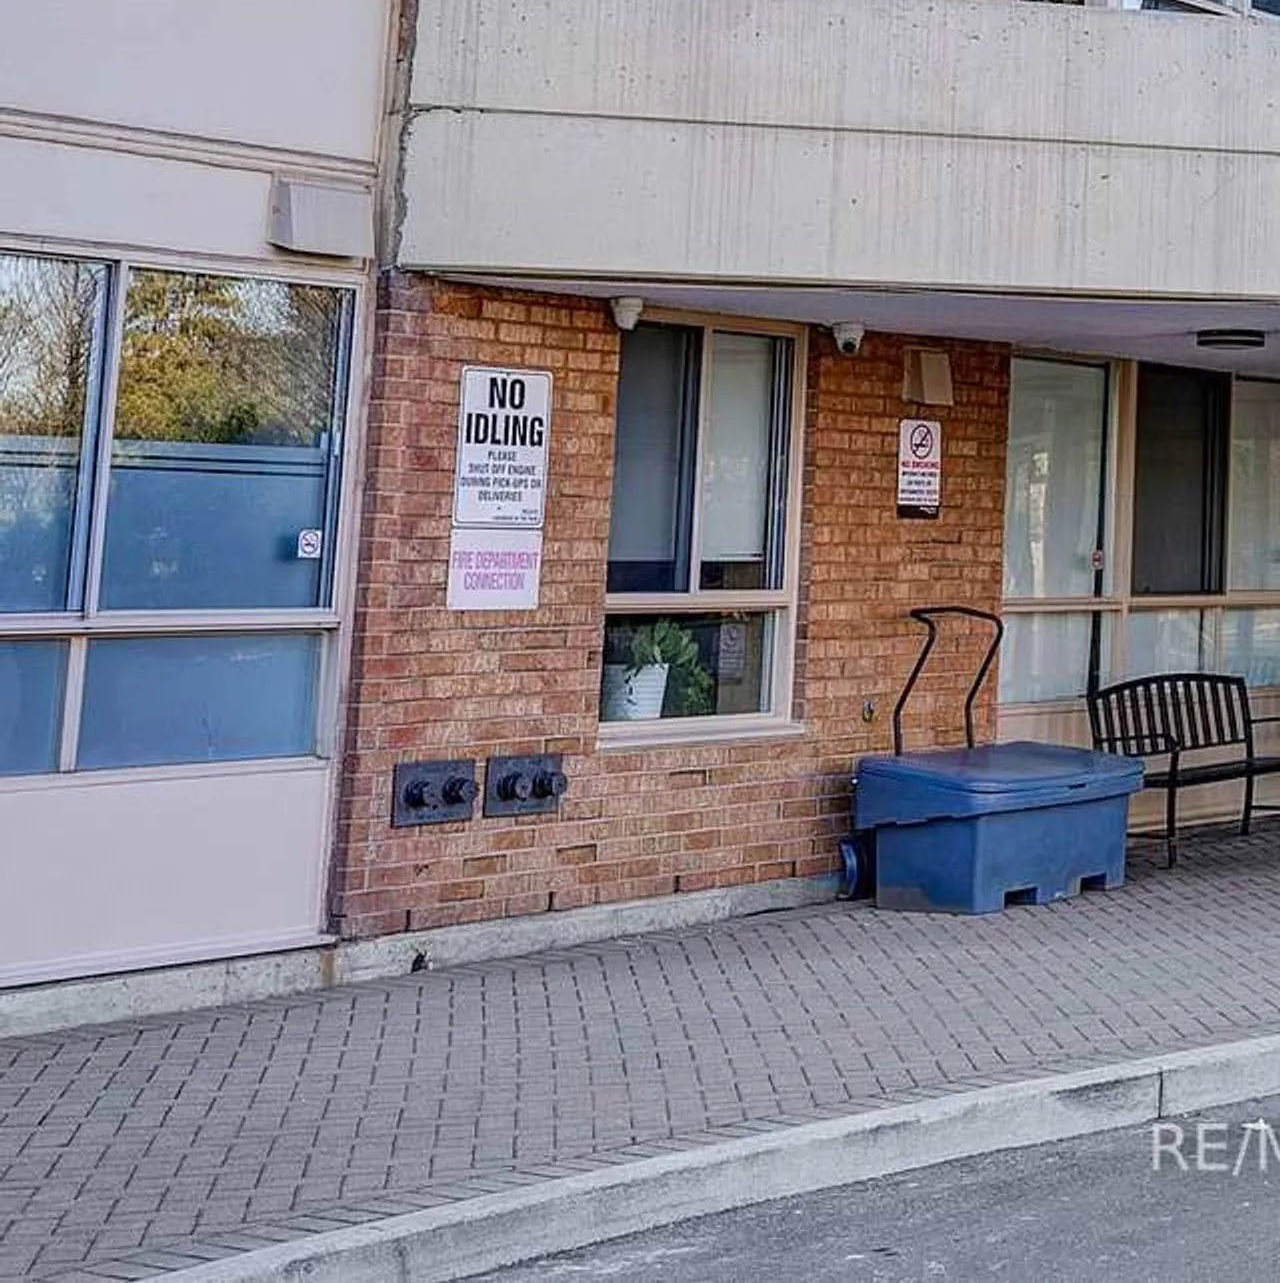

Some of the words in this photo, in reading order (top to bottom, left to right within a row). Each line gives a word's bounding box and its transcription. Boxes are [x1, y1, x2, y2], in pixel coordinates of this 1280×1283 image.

[489, 377, 526, 409] NO
[465, 413, 544, 447] IDLING
[487, 450, 517, 462] PLEASE
[491, 464, 506, 474] OFF
[453, 551, 474, 569] FIRE
[476, 551, 538, 569] DEPARTMENT
[464, 572, 525, 590] CONNECTION
